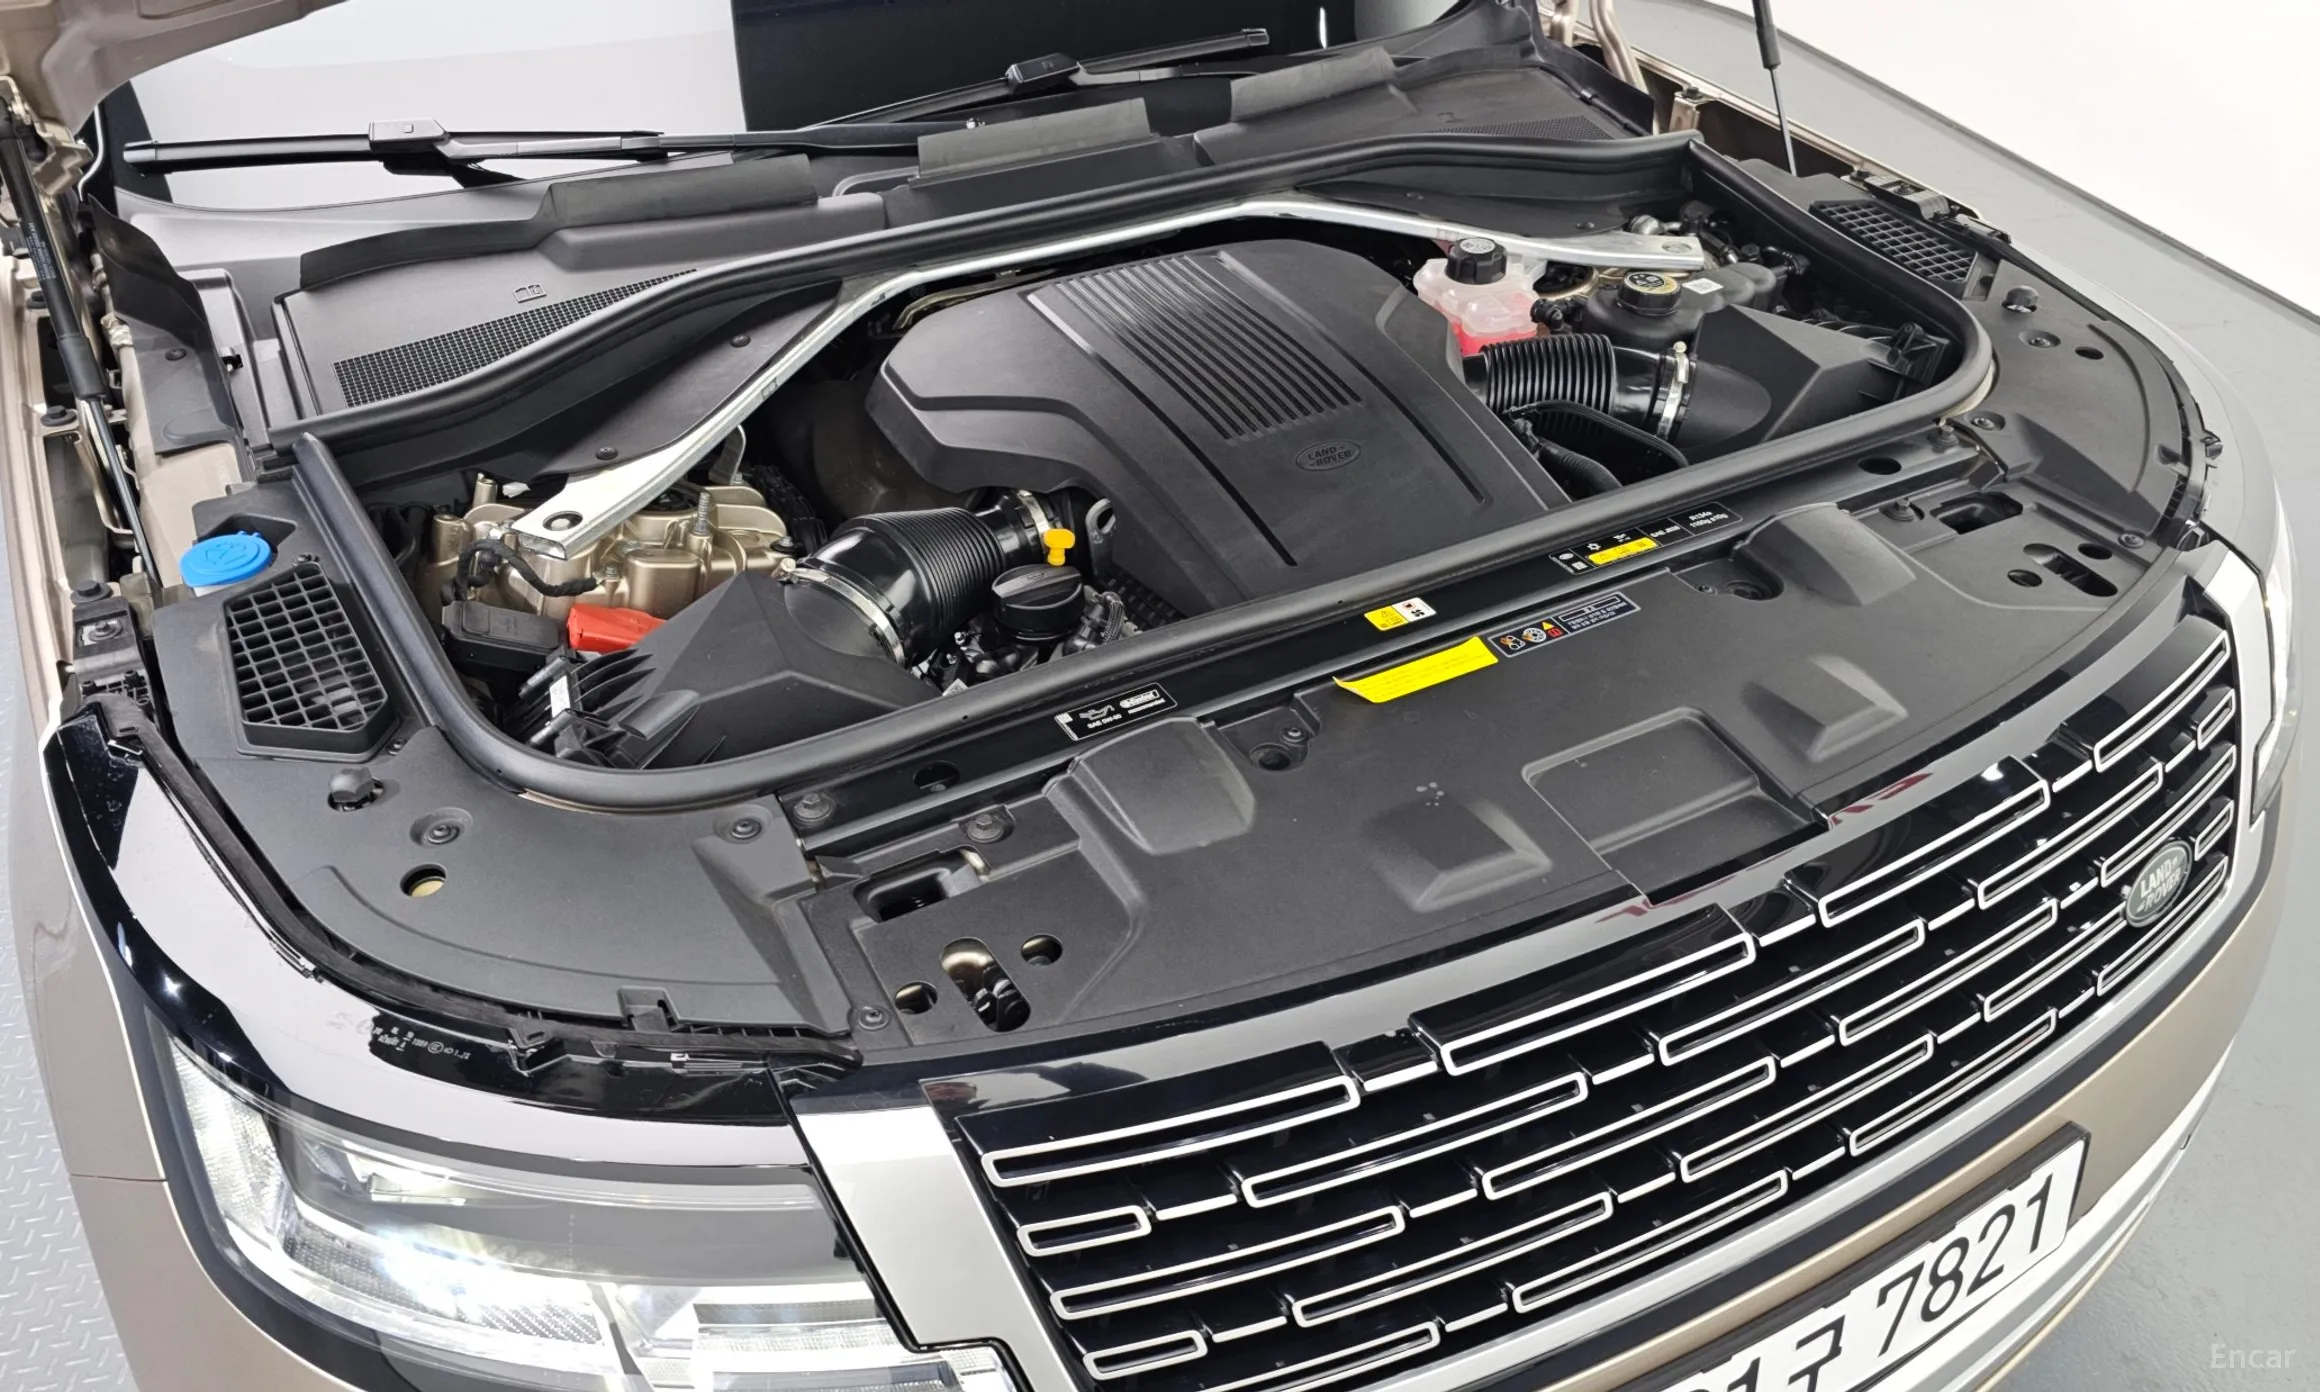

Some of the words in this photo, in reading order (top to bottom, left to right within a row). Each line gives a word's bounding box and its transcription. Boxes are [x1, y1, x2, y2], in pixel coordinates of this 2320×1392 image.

[1308, 446, 1338, 461] LAND
[1316, 450, 1352, 466] ROVER
[2140, 858, 2172, 899] LAND
[2144, 867, 2182, 912] ROVER
[1876, 1172, 2055, 1358] 7821
